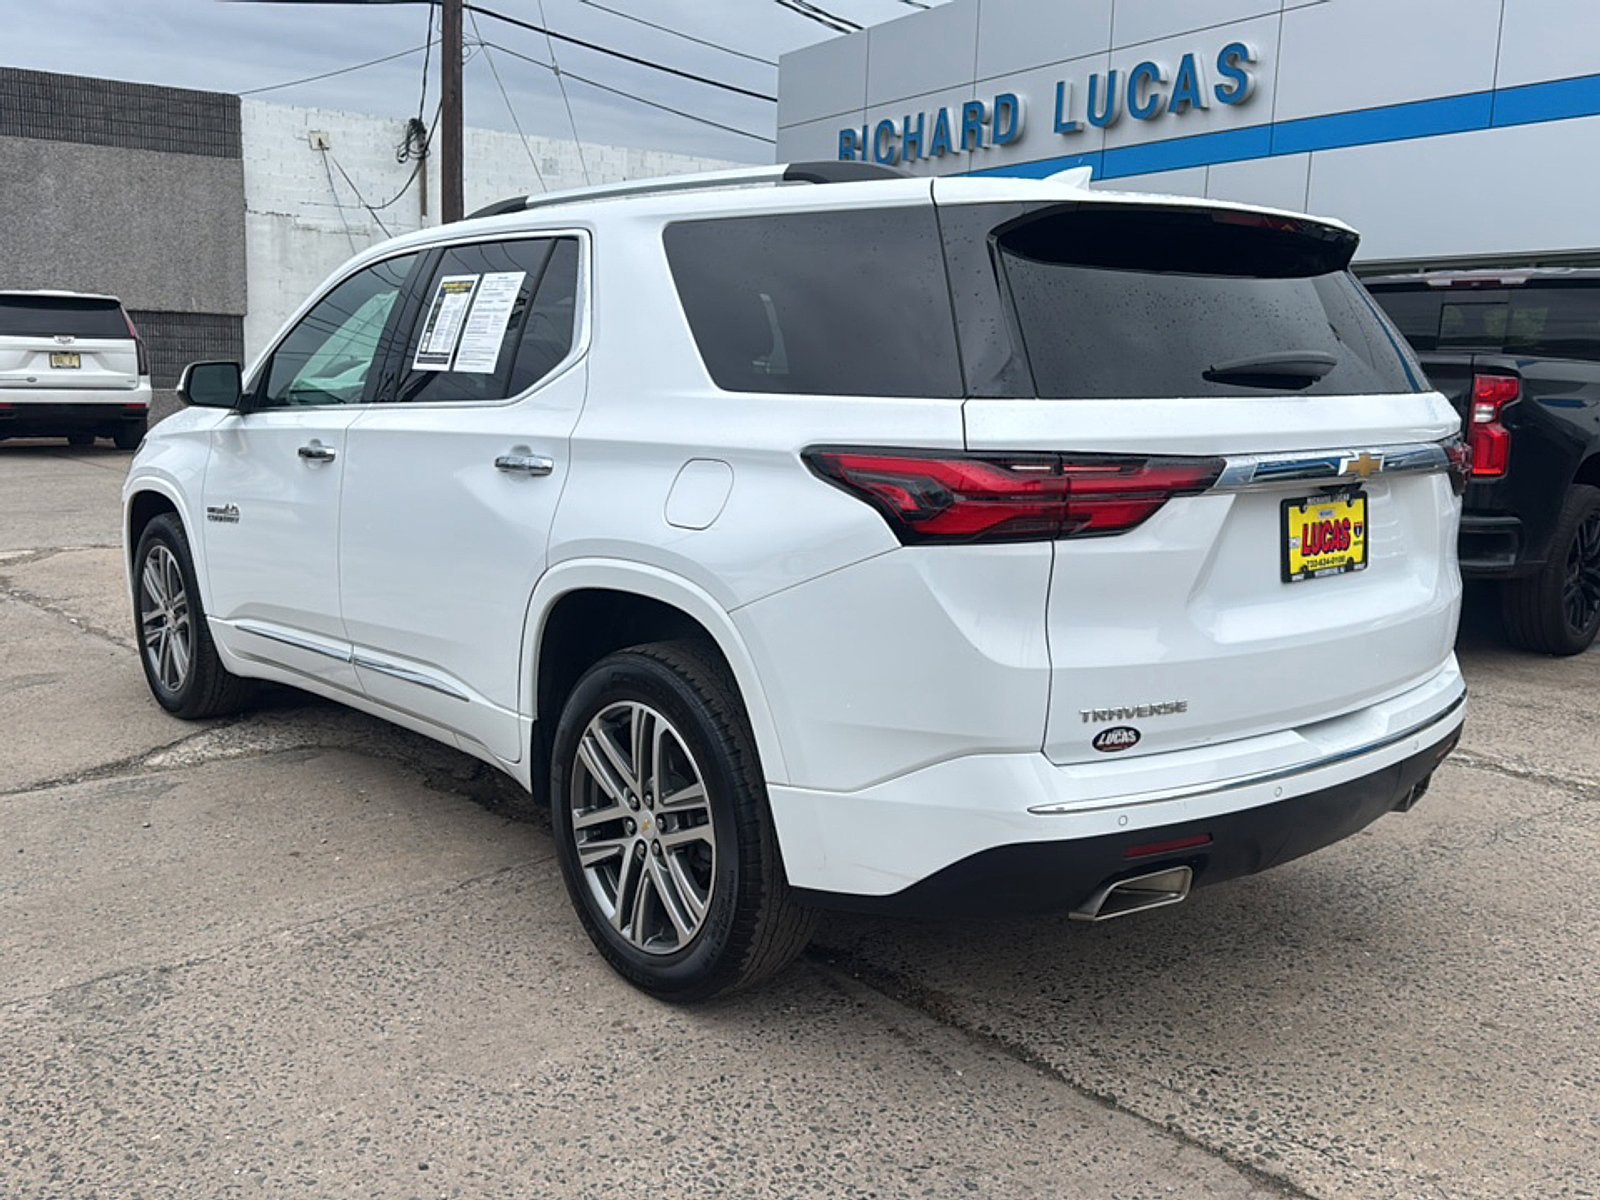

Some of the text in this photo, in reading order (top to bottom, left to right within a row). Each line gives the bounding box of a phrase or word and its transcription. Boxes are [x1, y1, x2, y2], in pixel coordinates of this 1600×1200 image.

[838, 42, 1254, 165] RICHARD LUCAS
[1302, 518, 1351, 556] LUCAS
[1079, 700, 1188, 723] TRAVERSE
[1096, 729, 1138, 747] LUCAS
